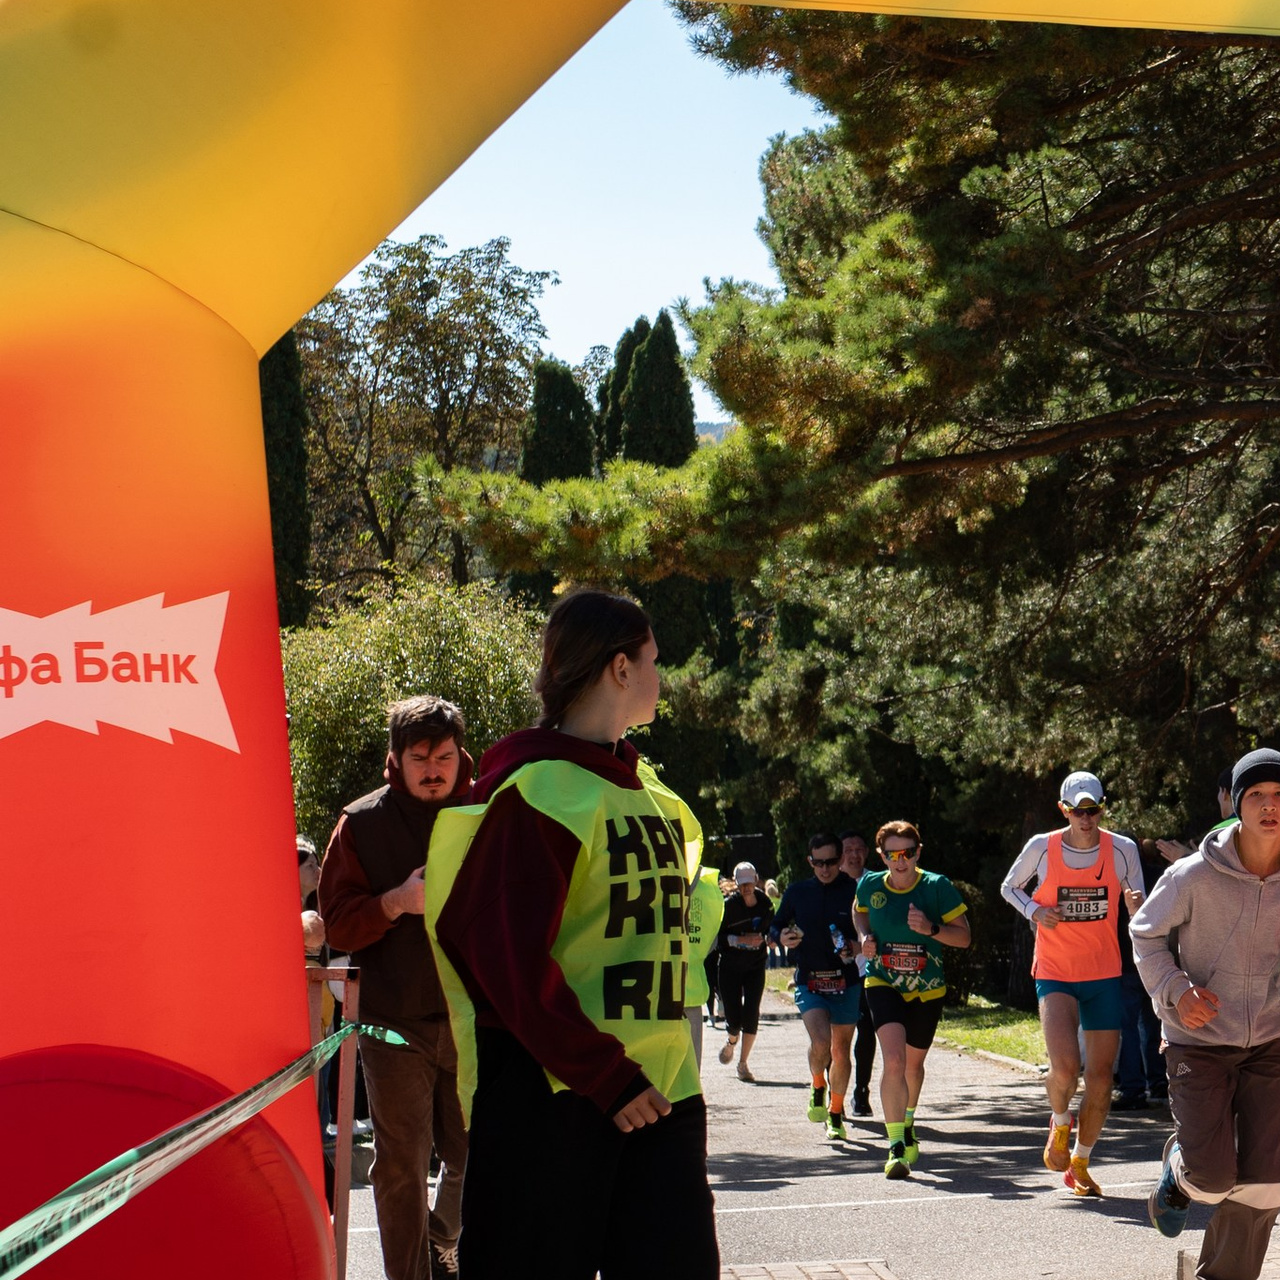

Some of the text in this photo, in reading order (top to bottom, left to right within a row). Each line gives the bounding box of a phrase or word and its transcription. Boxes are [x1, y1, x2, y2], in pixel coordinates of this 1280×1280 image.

[74, 641, 199, 684] Банк
[604, 875, 689, 938] KA
[1066, 902, 1100, 913] 4083
[889, 956, 919, 968] 6159
[603, 960, 688, 1020] RU
